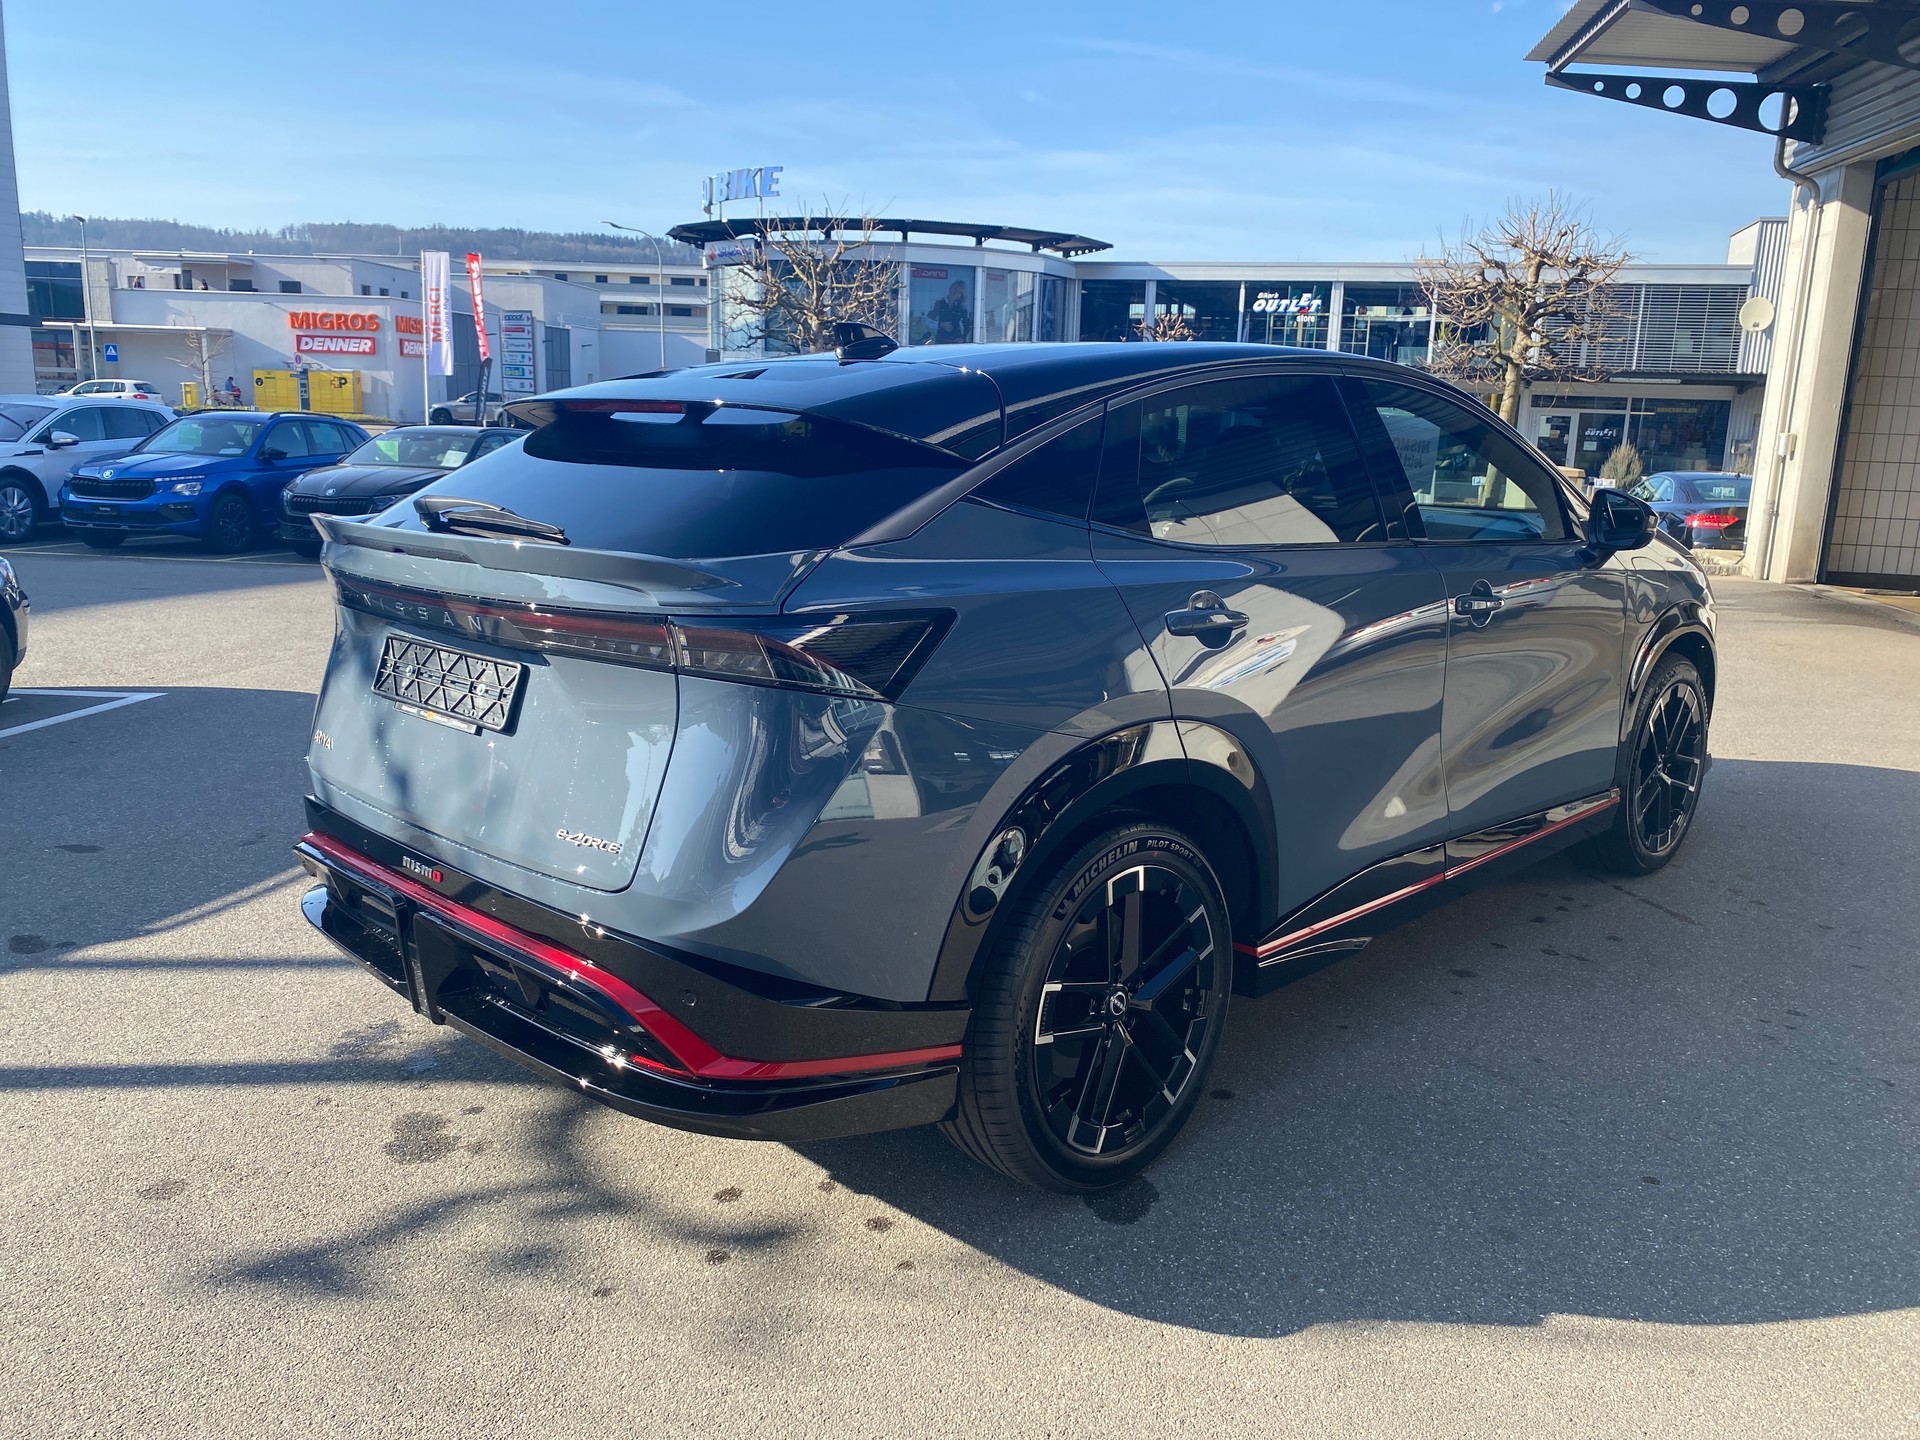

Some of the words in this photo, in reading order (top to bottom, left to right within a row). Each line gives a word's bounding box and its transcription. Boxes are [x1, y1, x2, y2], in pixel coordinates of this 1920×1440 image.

[714, 166, 783, 202] BIKE
[1252, 293, 1322, 313] OUTLET
[288, 311, 380, 332] MIGROS
[429, 287, 442, 343] MERCI
[1296, 314, 1315, 322] store
[300, 337, 372, 352] DENNER
[1584, 428, 1613, 437] OUTLET
[363, 592, 483, 632] NISSAN
[1073, 840, 1138, 898] MICHELIN
[1146, 839, 1170, 849] PILOT
[1170, 843, 1194, 859] SPORT
